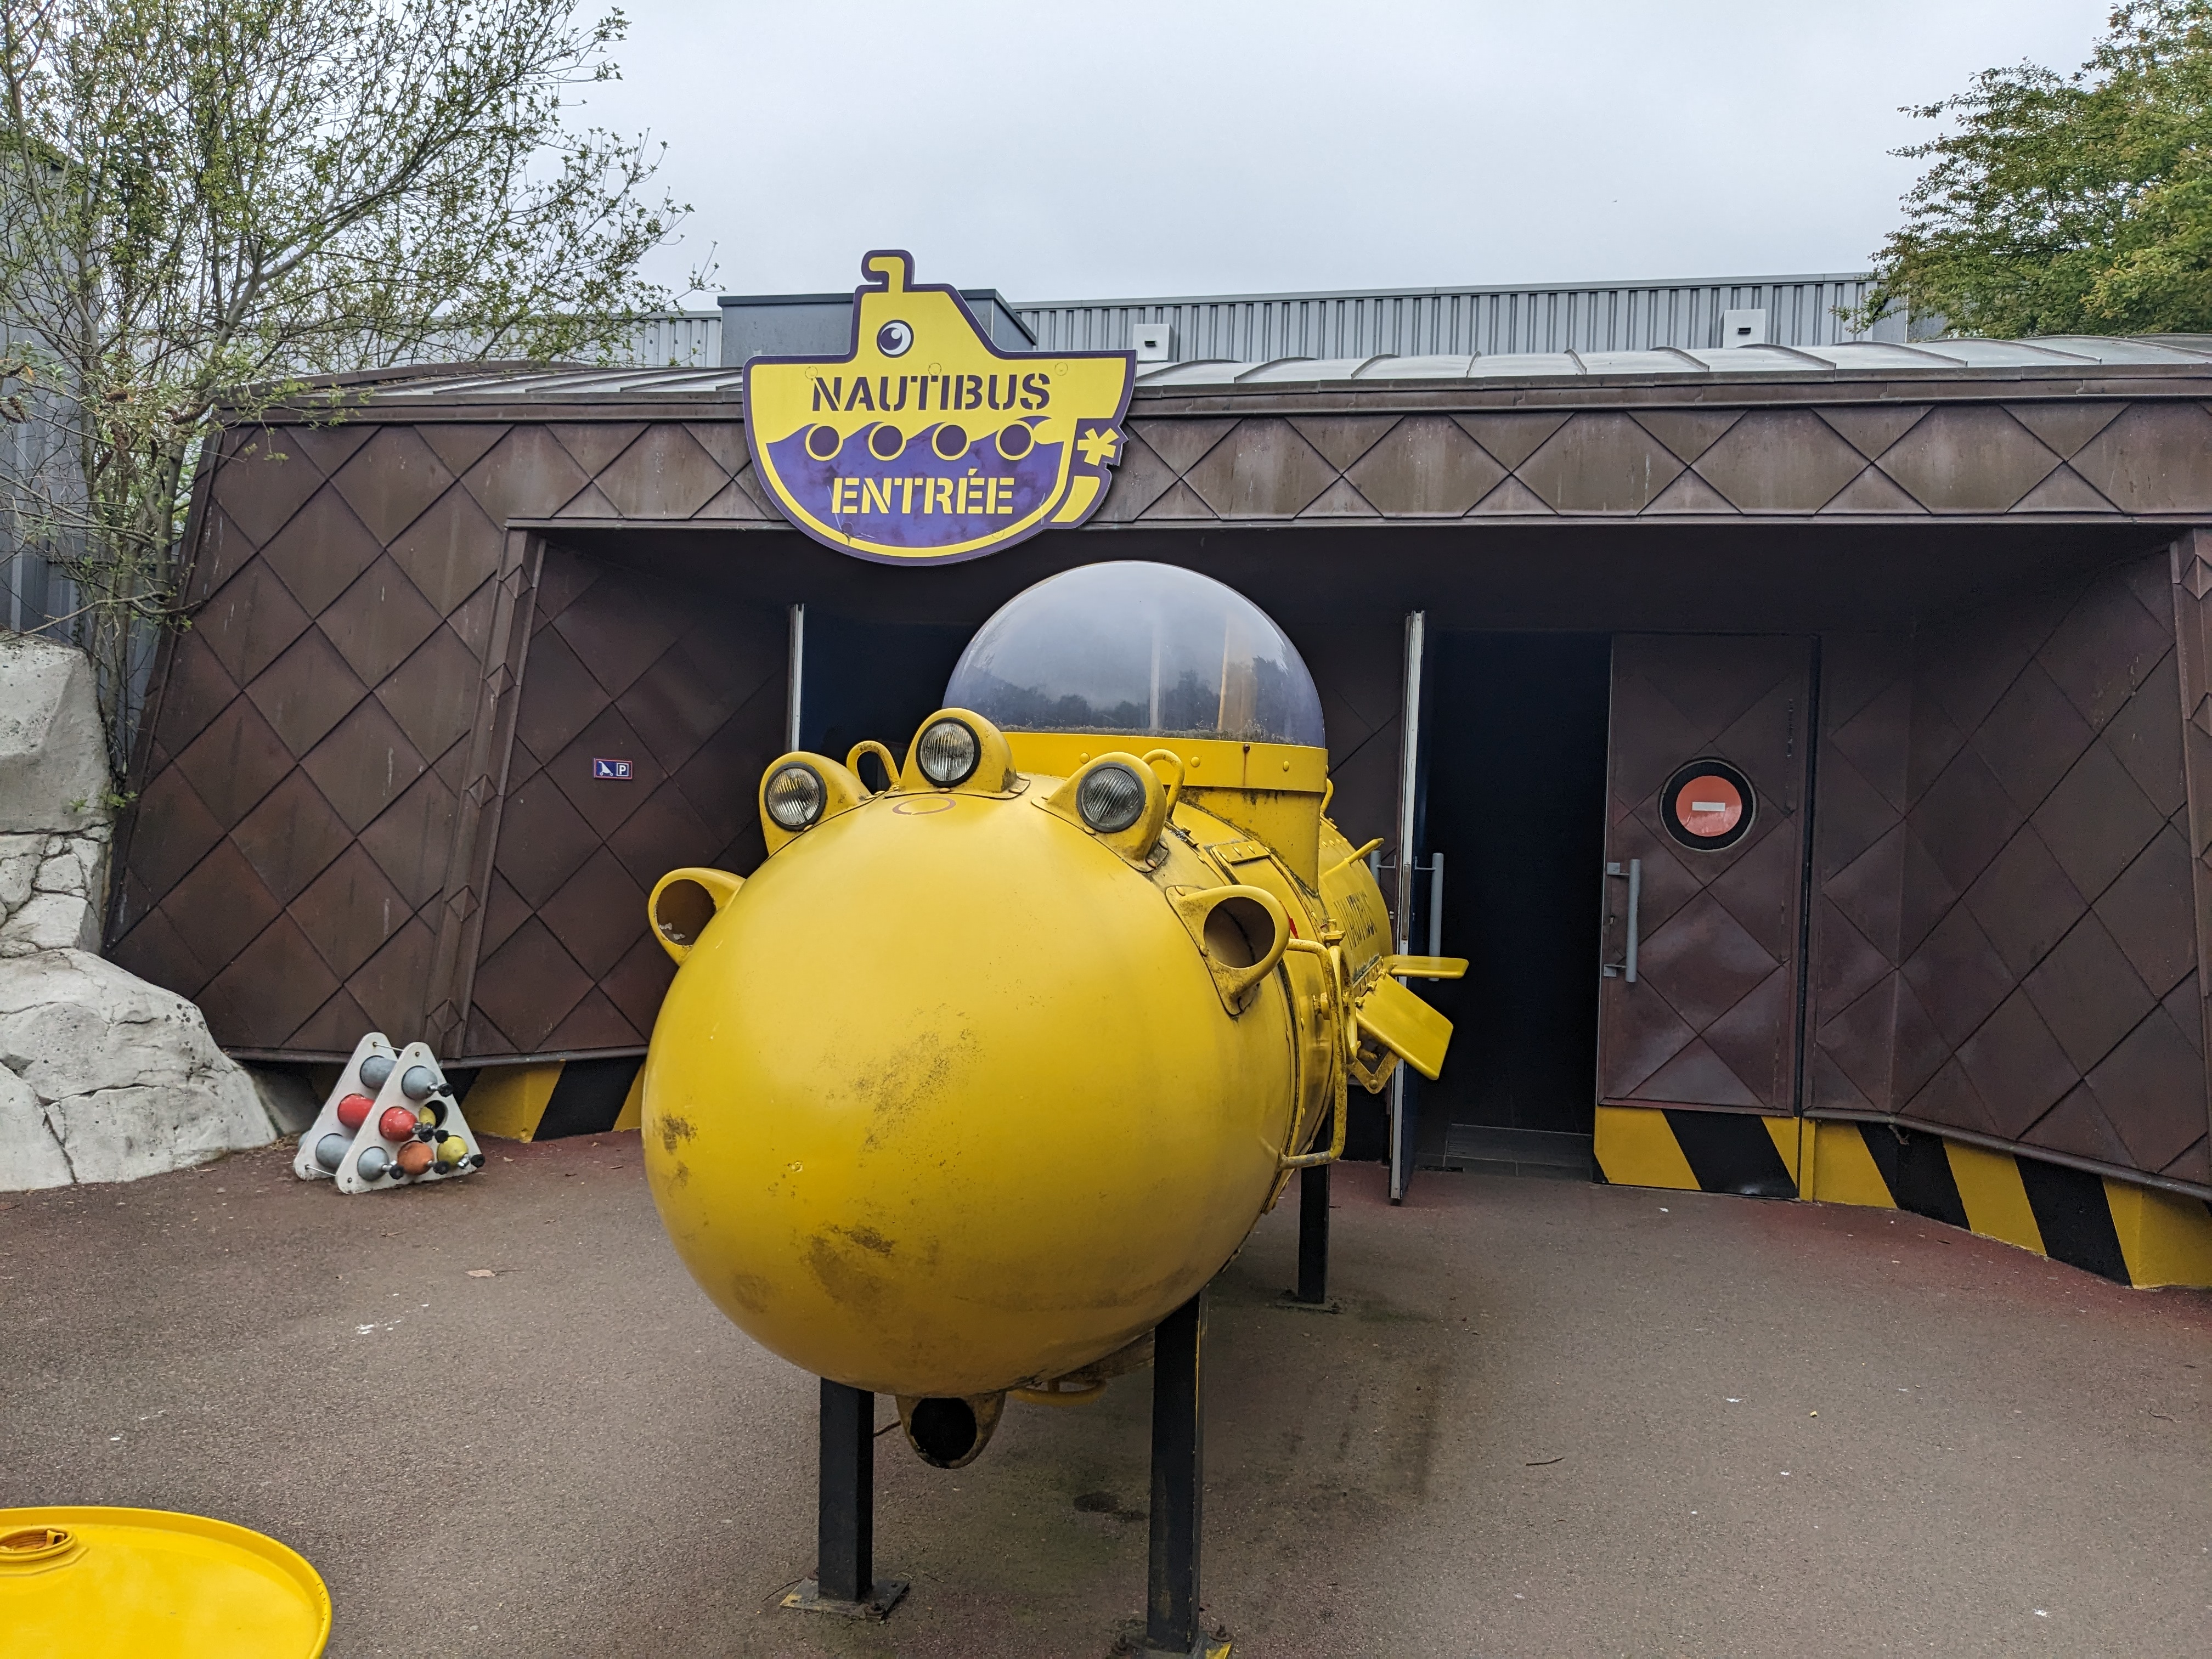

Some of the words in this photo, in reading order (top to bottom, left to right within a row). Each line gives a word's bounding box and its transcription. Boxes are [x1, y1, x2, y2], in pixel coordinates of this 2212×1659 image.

[812, 373, 1050, 411] NAUTIBUS
[833, 469, 1015, 514] ENTRÉE
[619, 765, 627, 775] P
